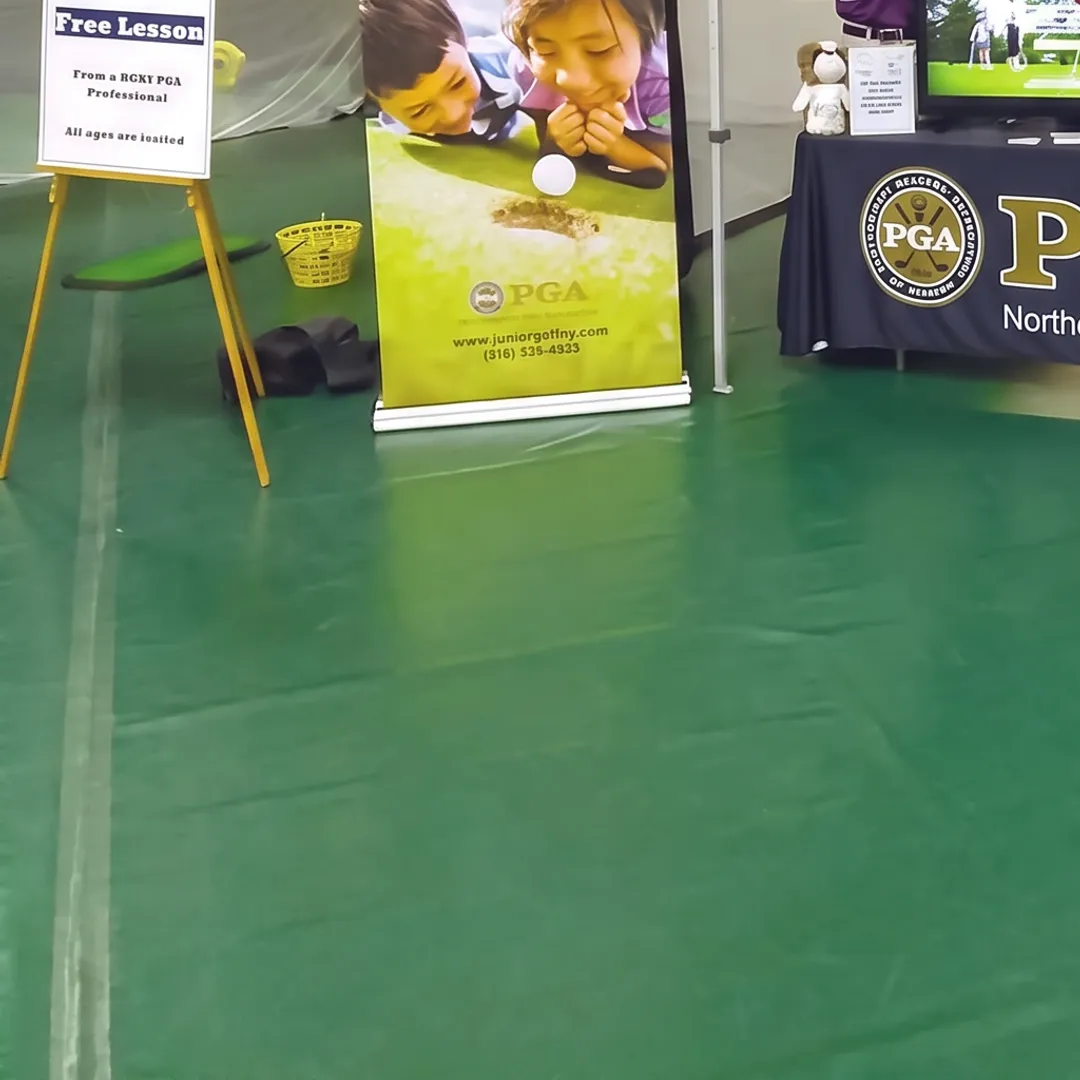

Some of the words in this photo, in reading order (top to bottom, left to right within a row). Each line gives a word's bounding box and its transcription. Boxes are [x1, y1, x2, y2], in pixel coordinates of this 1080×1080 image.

[55, 11, 112, 35] Free
[117, 17, 204, 41] Lesson
[73, 70, 107, 82] From
[109, 74, 117, 82] a
[156, 76, 182, 87] PGA
[87, 88, 168, 103] Professional
[65, 126, 83, 137] All
[85, 131, 114, 142] ages
[117, 133, 138, 142] are
[882, 222, 960, 253] PGA
[509, 280, 589, 306] PGA
